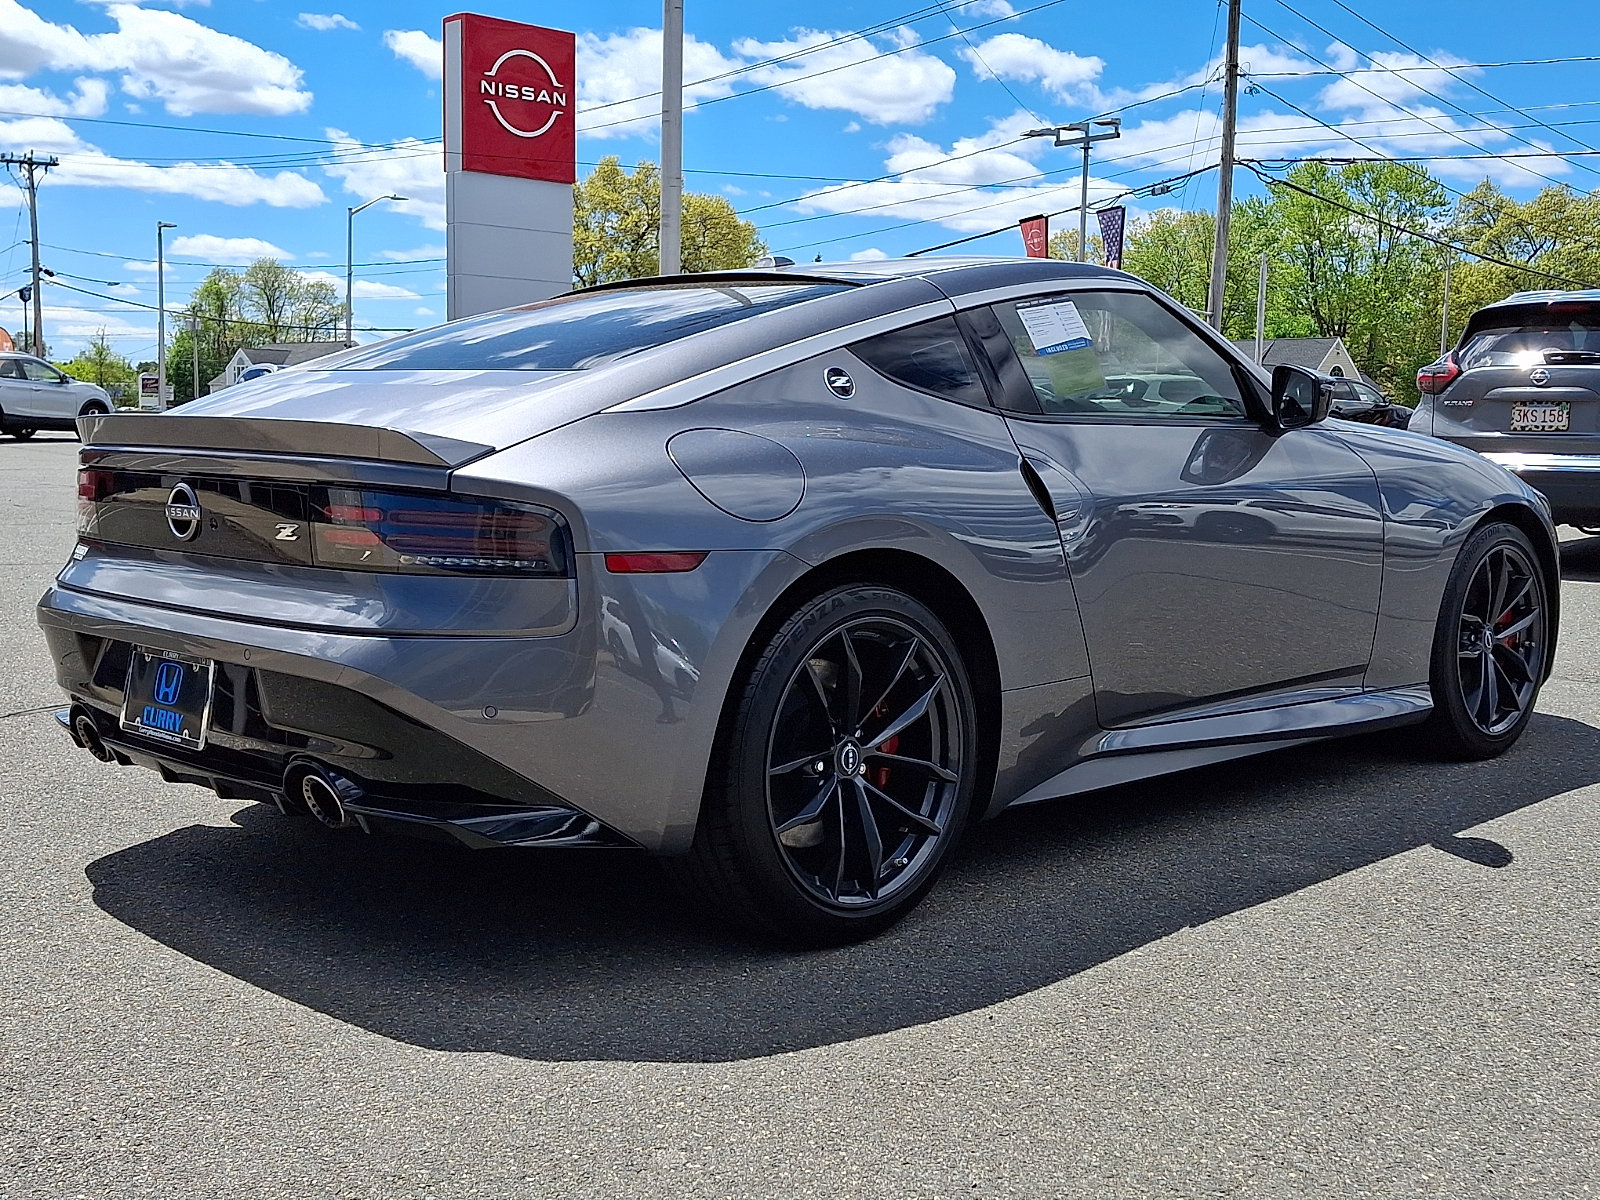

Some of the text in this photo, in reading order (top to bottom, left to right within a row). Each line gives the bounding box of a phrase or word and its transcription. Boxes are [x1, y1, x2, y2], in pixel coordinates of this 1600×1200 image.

[481, 80, 566, 106] NISSAN
[1515, 409, 1564, 423] 3KS 158
[275, 523, 300, 541] Z
[143, 705, 184, 732] CURRY
